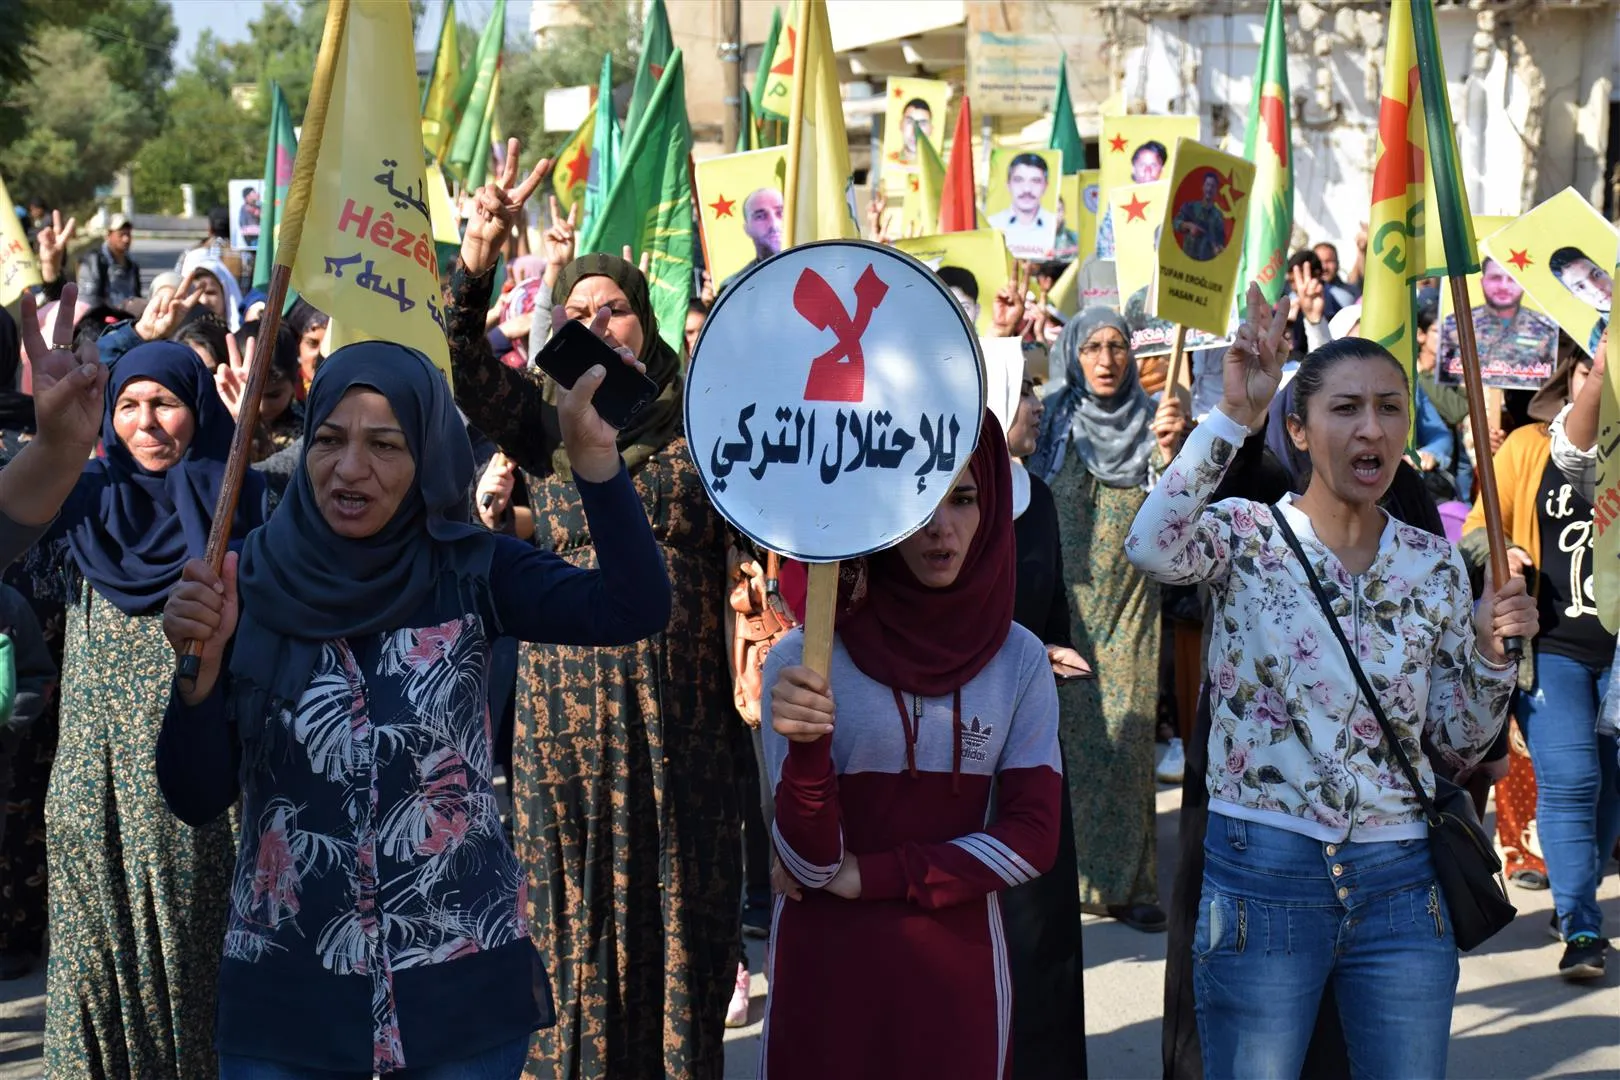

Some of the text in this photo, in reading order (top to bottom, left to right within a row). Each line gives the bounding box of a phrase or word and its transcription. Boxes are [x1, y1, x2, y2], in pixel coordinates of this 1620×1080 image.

[1168, 287, 1194, 302] HASAN
[793, 263, 890, 403] لا
[711, 402, 960, 495] للإحتلال التركي
[960, 747, 987, 761] didas
